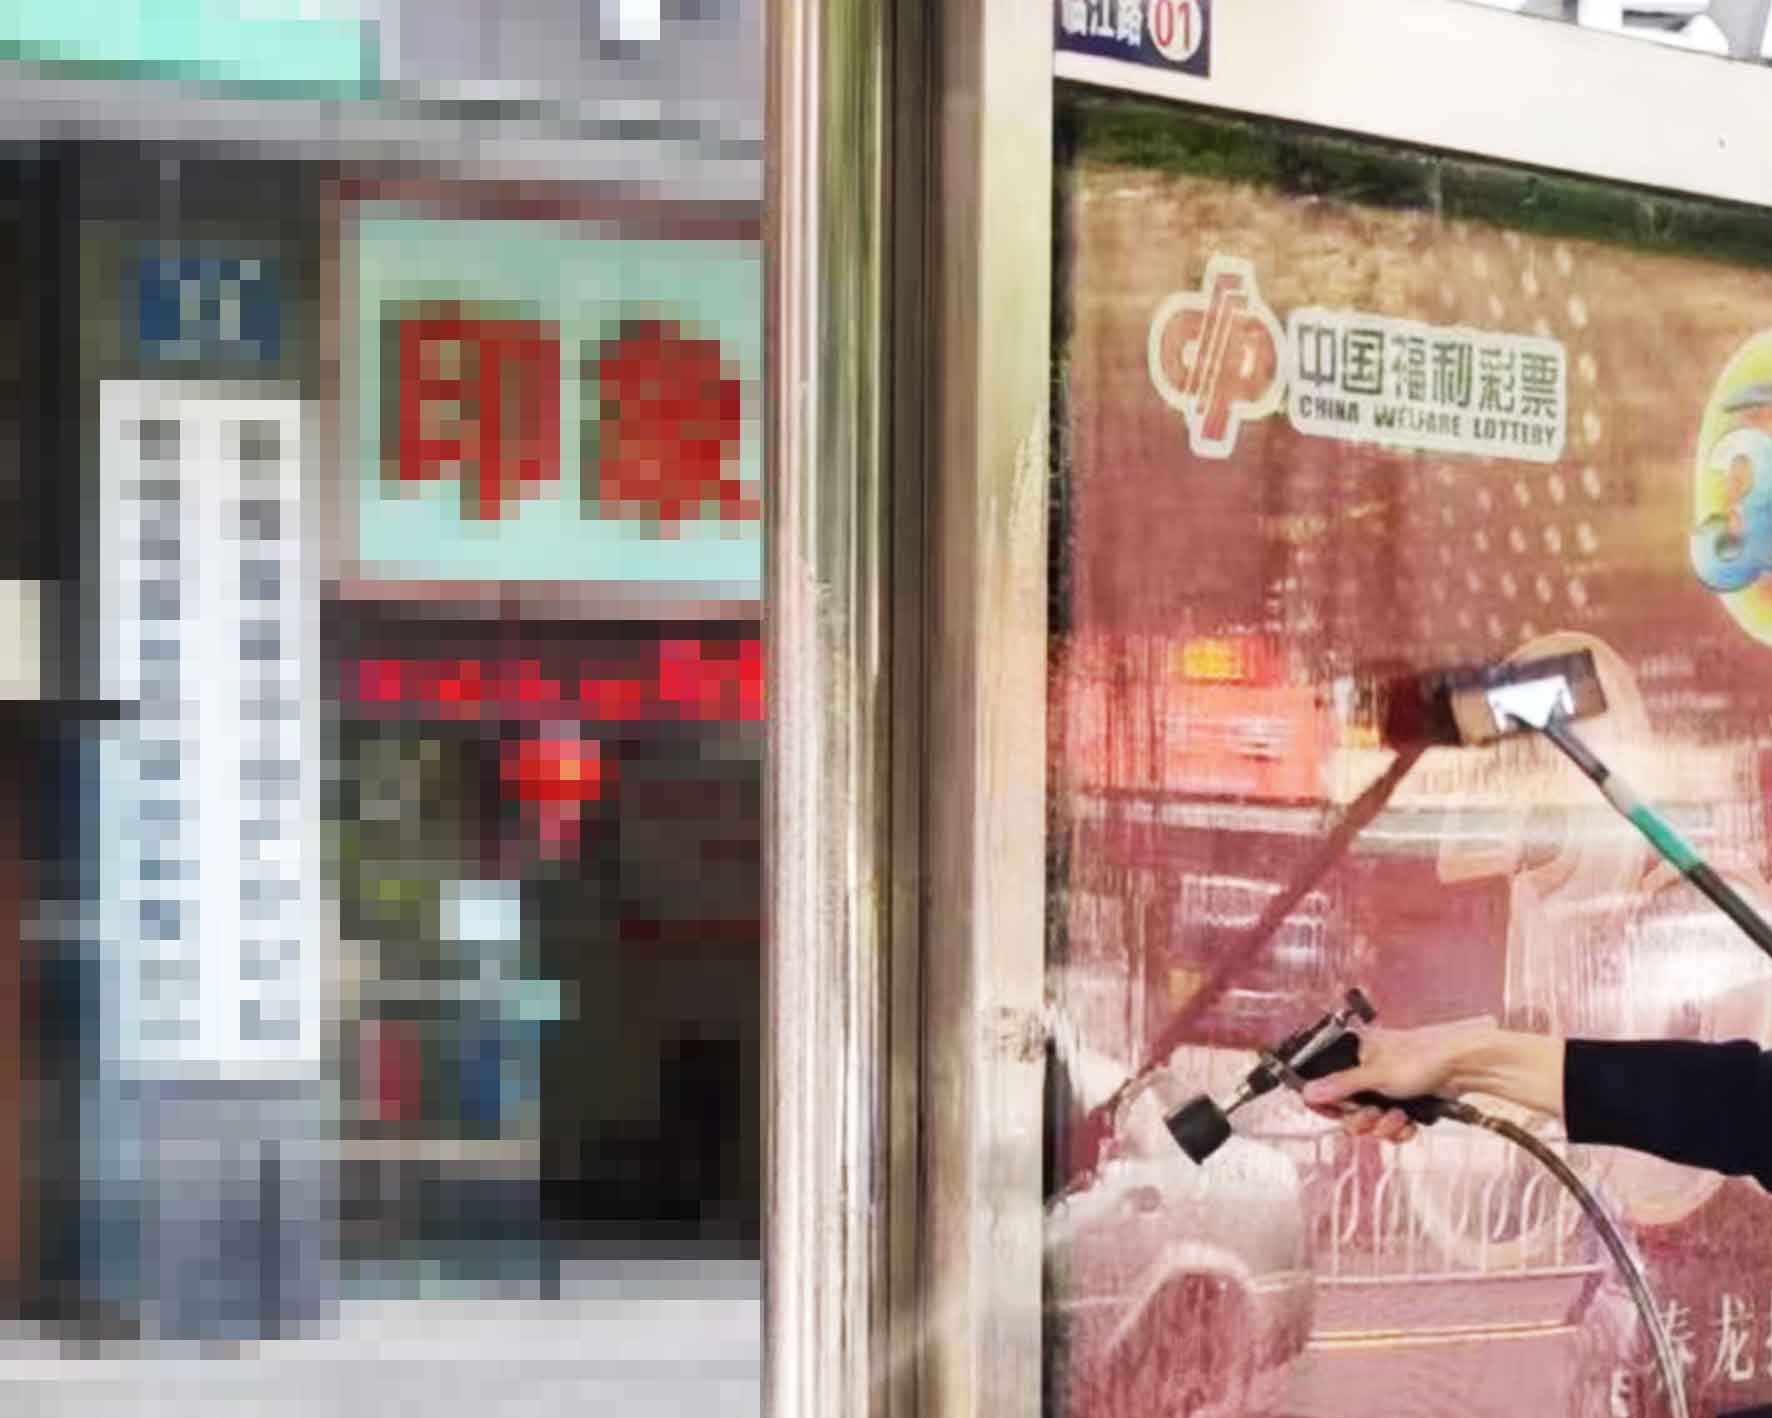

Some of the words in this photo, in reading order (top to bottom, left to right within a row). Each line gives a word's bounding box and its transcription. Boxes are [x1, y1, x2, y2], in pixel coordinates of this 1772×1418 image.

[1154, 1, 1191, 49] 01
[1298, 324, 1558, 419] 中国福利彩票
[1298, 396, 1360, 422] CHINA
[1472, 419, 1557, 447] LOTTERY
